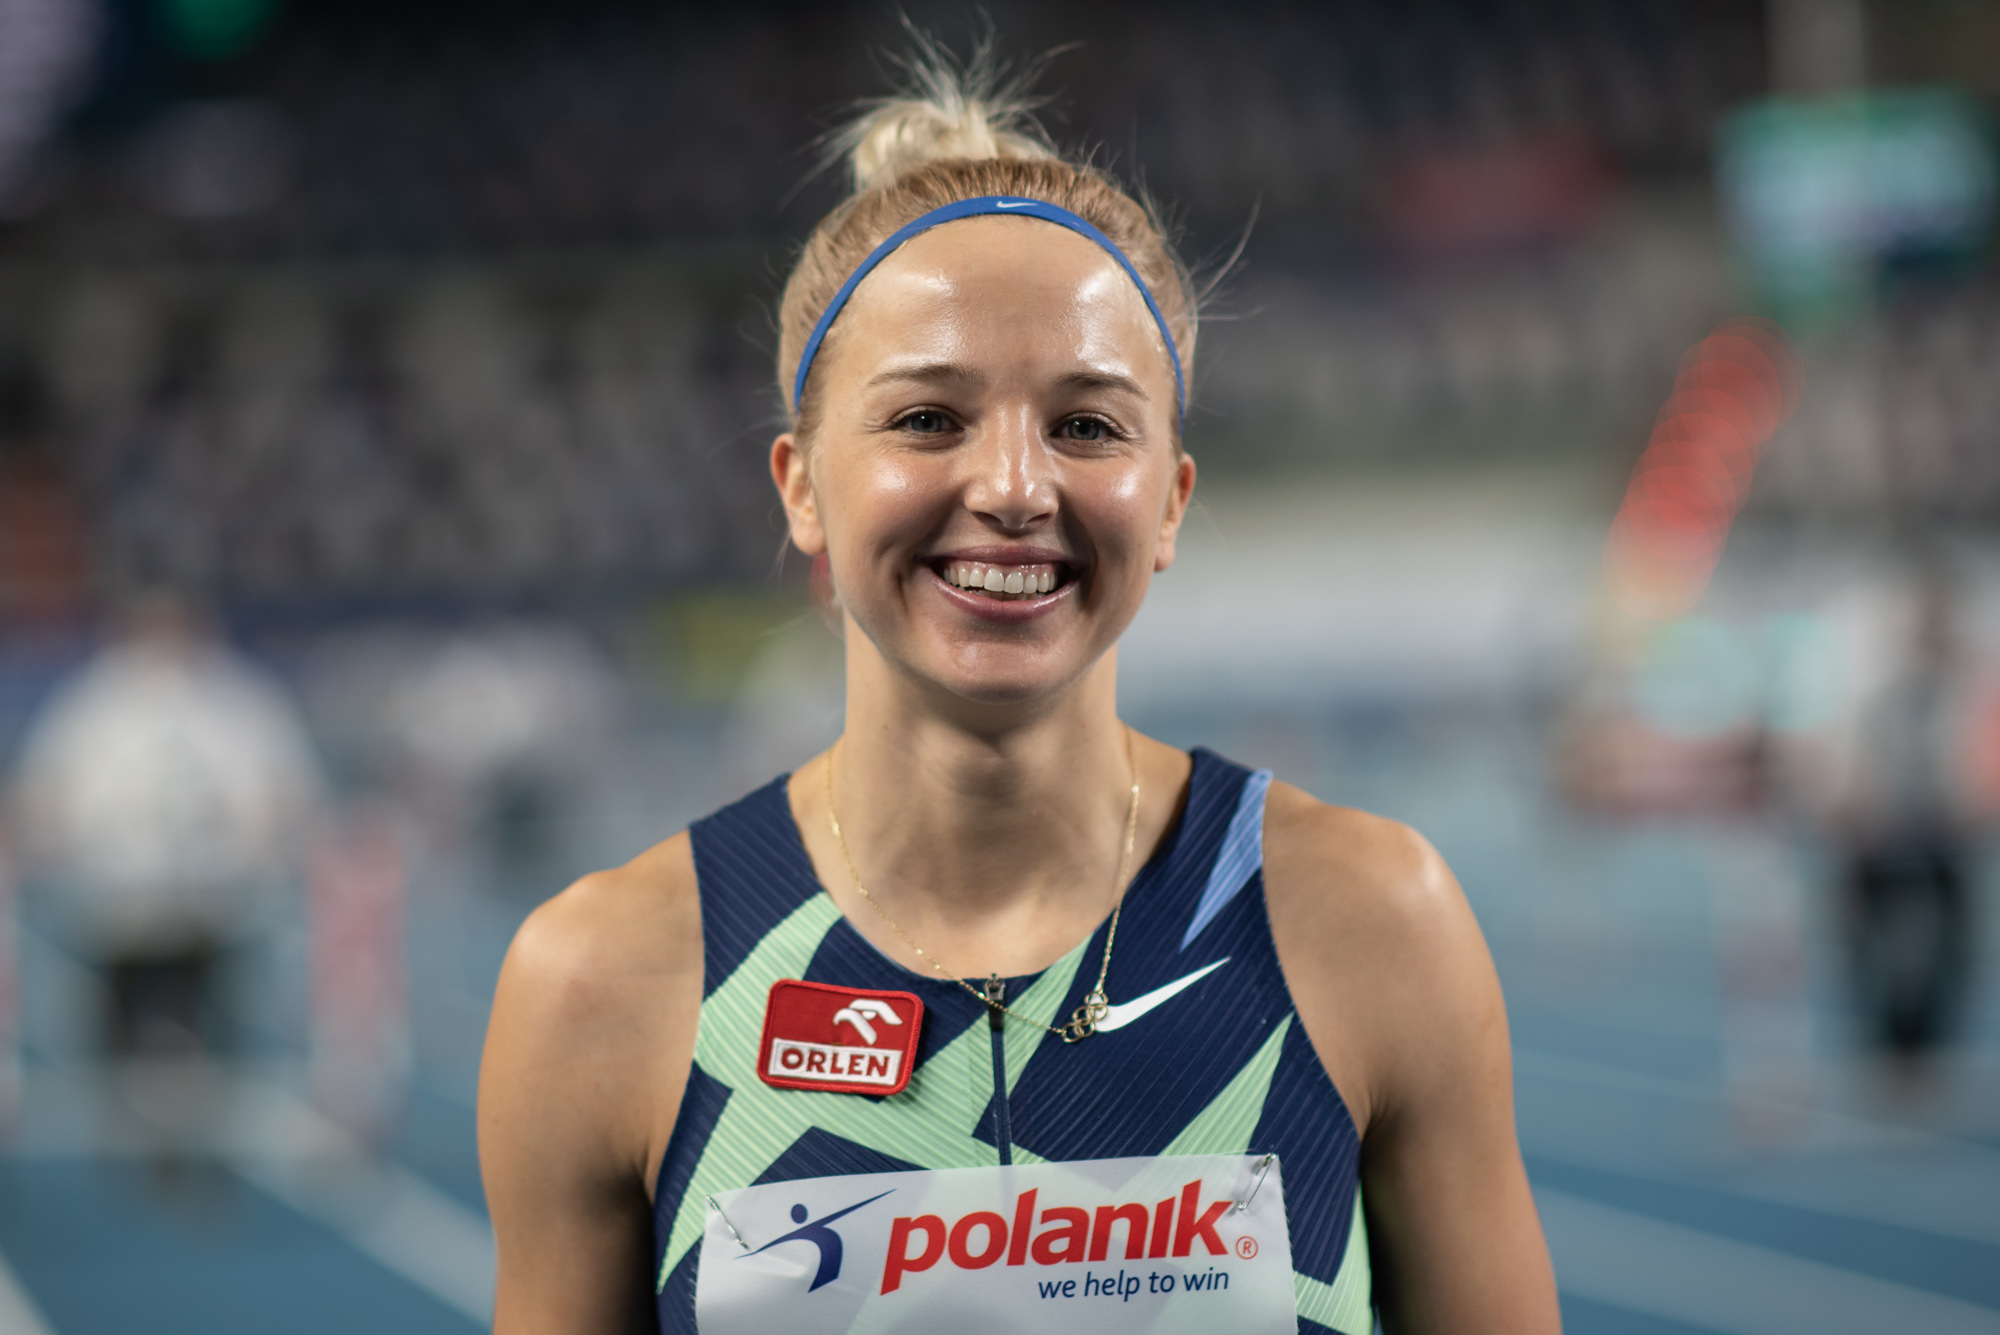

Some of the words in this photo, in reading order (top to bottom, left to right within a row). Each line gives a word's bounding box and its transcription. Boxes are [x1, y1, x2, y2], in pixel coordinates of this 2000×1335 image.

[781, 1048, 889, 1077] ORLEN
[880, 1178, 1234, 1296] polanik
[1038, 1276, 1077, 1299] we
[1083, 1270, 1140, 1302] help
[1147, 1272, 1176, 1294] to
[1182, 1266, 1230, 1292] win
